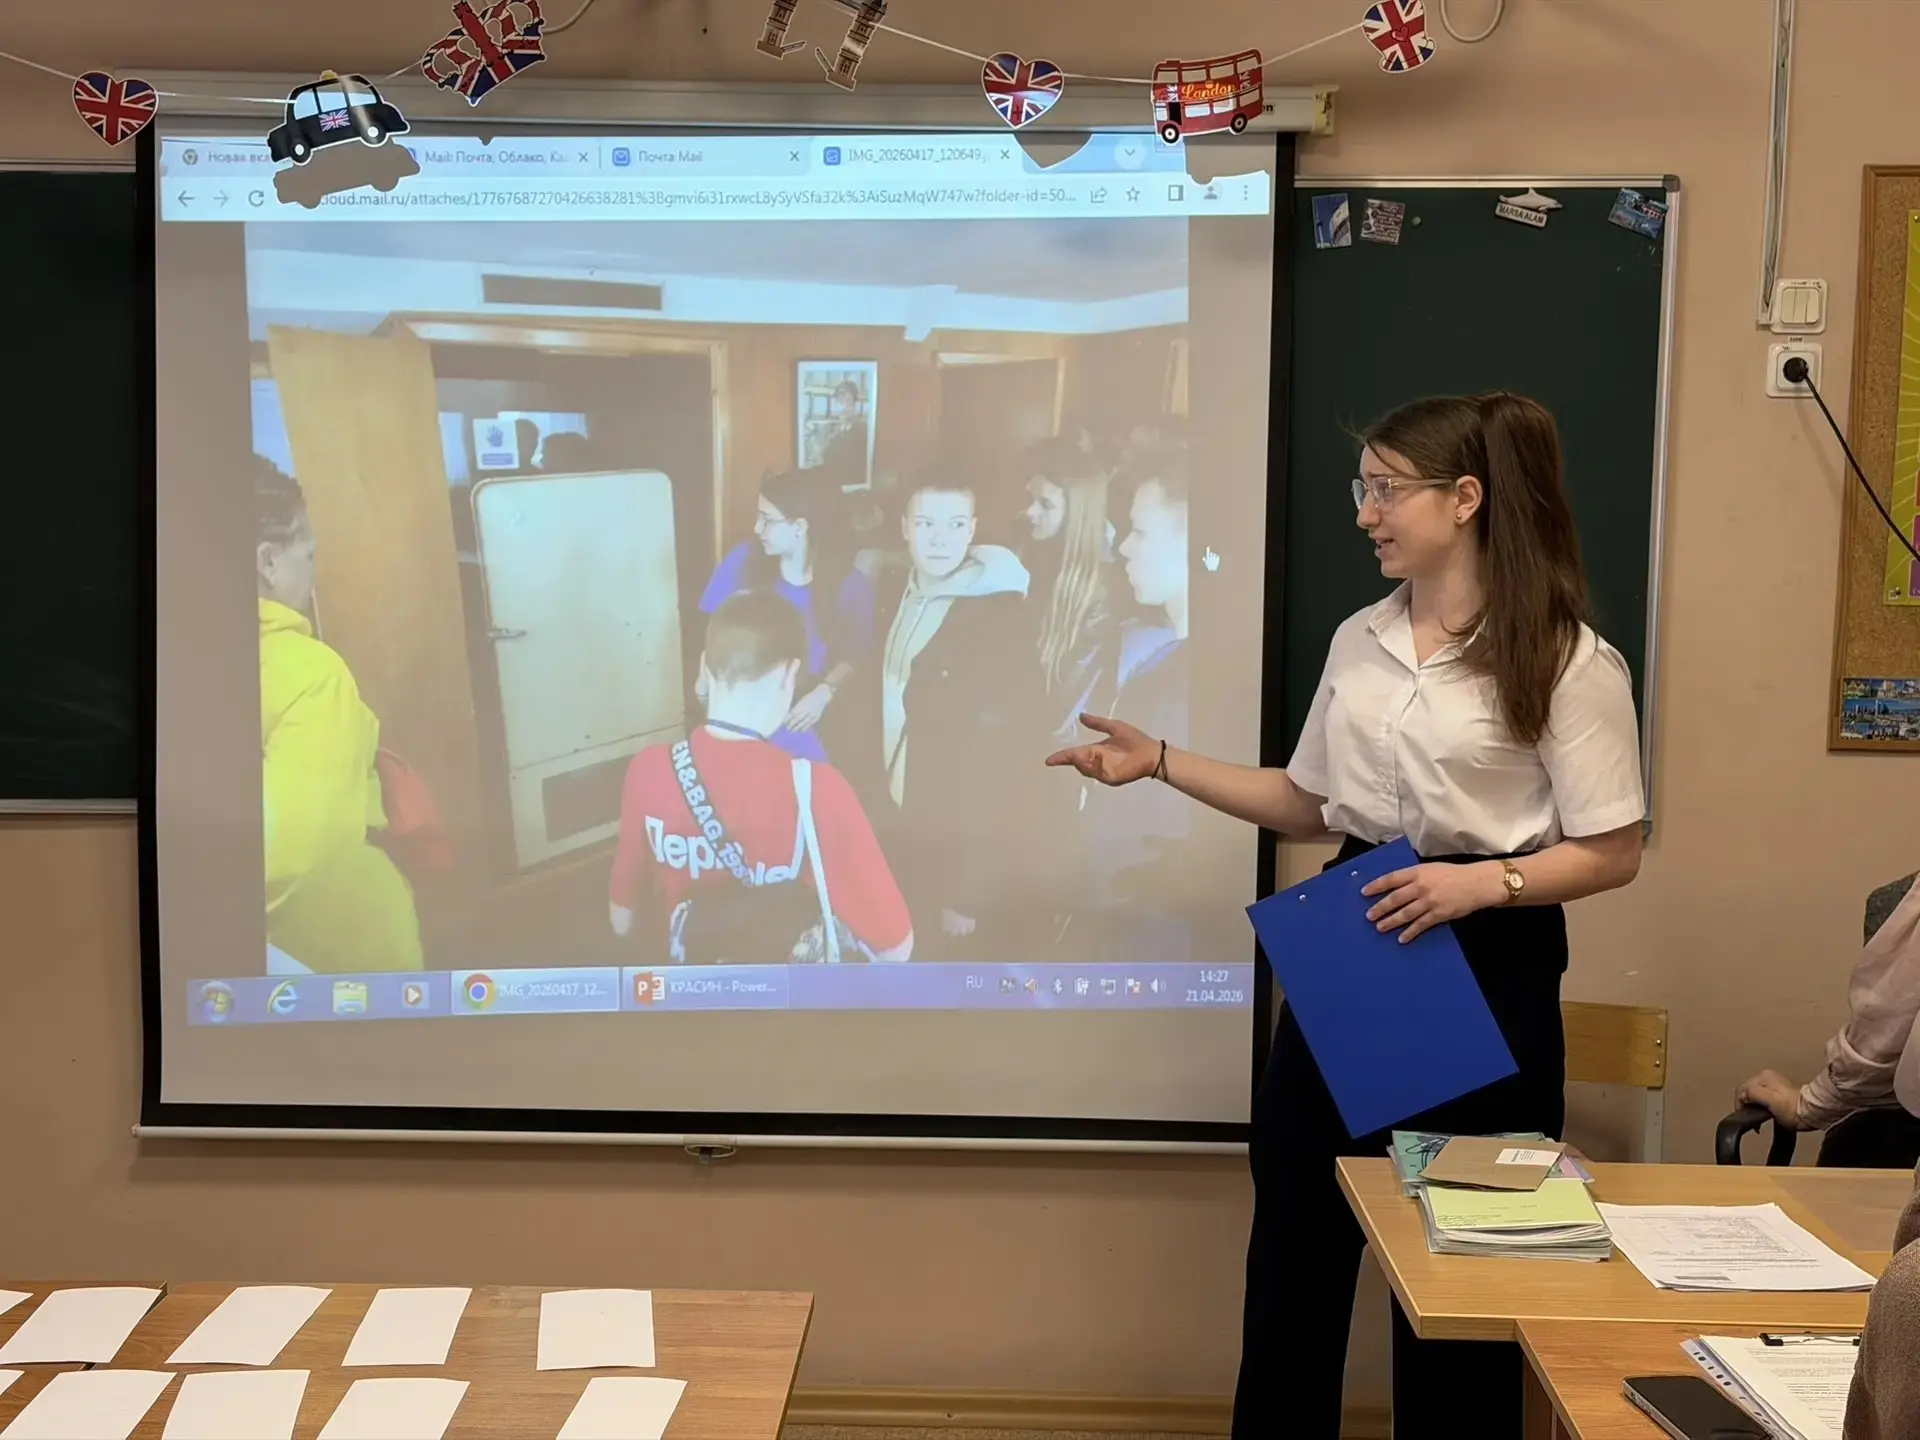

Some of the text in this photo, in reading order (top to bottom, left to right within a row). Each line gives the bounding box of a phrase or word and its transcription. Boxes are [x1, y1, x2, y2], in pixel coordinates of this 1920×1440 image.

[1181, 82, 1236, 100] London
[208, 151, 246, 163] Новая
[425, 151, 451, 163] Mail:
[456, 151, 495, 165] Почта,
[499, 150, 547, 165] Облако,
[639, 150, 703, 163] Почта Mail
[1523, 211, 1545, 224] ALAM
[966, 976, 983, 989] RU
[1199, 970, 1229, 983] 14:27
[670, 981, 722, 993] КРАСИН
[1186, 988, 1244, 1003] 21.04.2026
